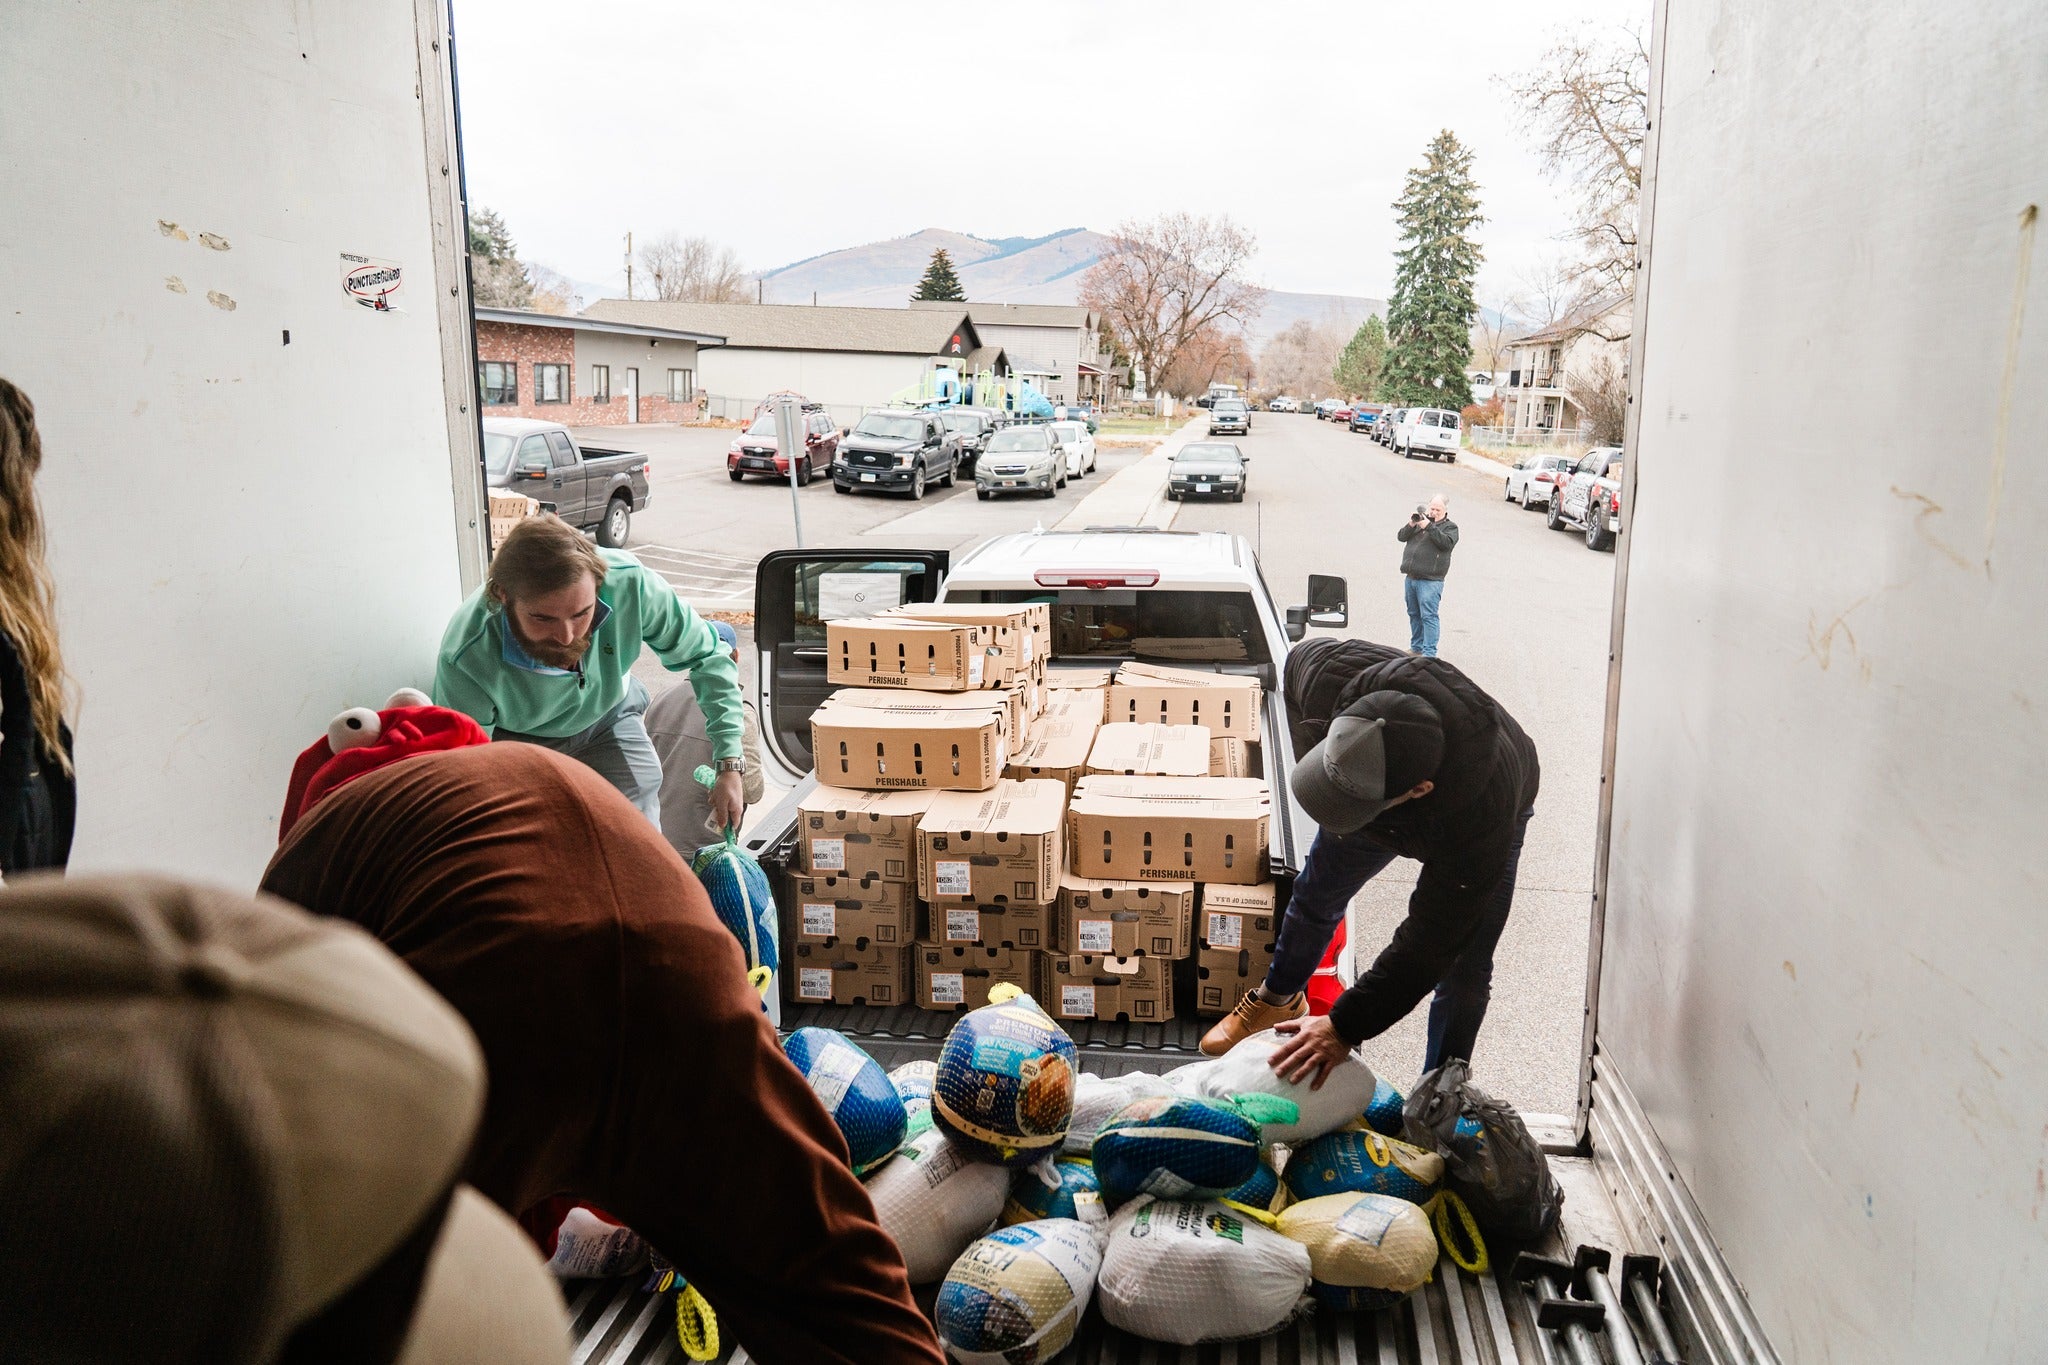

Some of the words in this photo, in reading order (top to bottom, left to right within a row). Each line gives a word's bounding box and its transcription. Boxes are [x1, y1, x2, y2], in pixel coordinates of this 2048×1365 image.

[340, 253, 363, 263] PROTECTED
[868, 676, 908, 686] PERISHABLE
[876, 778, 927, 786] PERISHABLE
[1140, 869, 1196, 879] PERISHABLE
[996, 1018, 1050, 1040] PREMIUM
[1052, 1234, 1078, 1250] fresh
[970, 1263, 997, 1277] TURKEY
